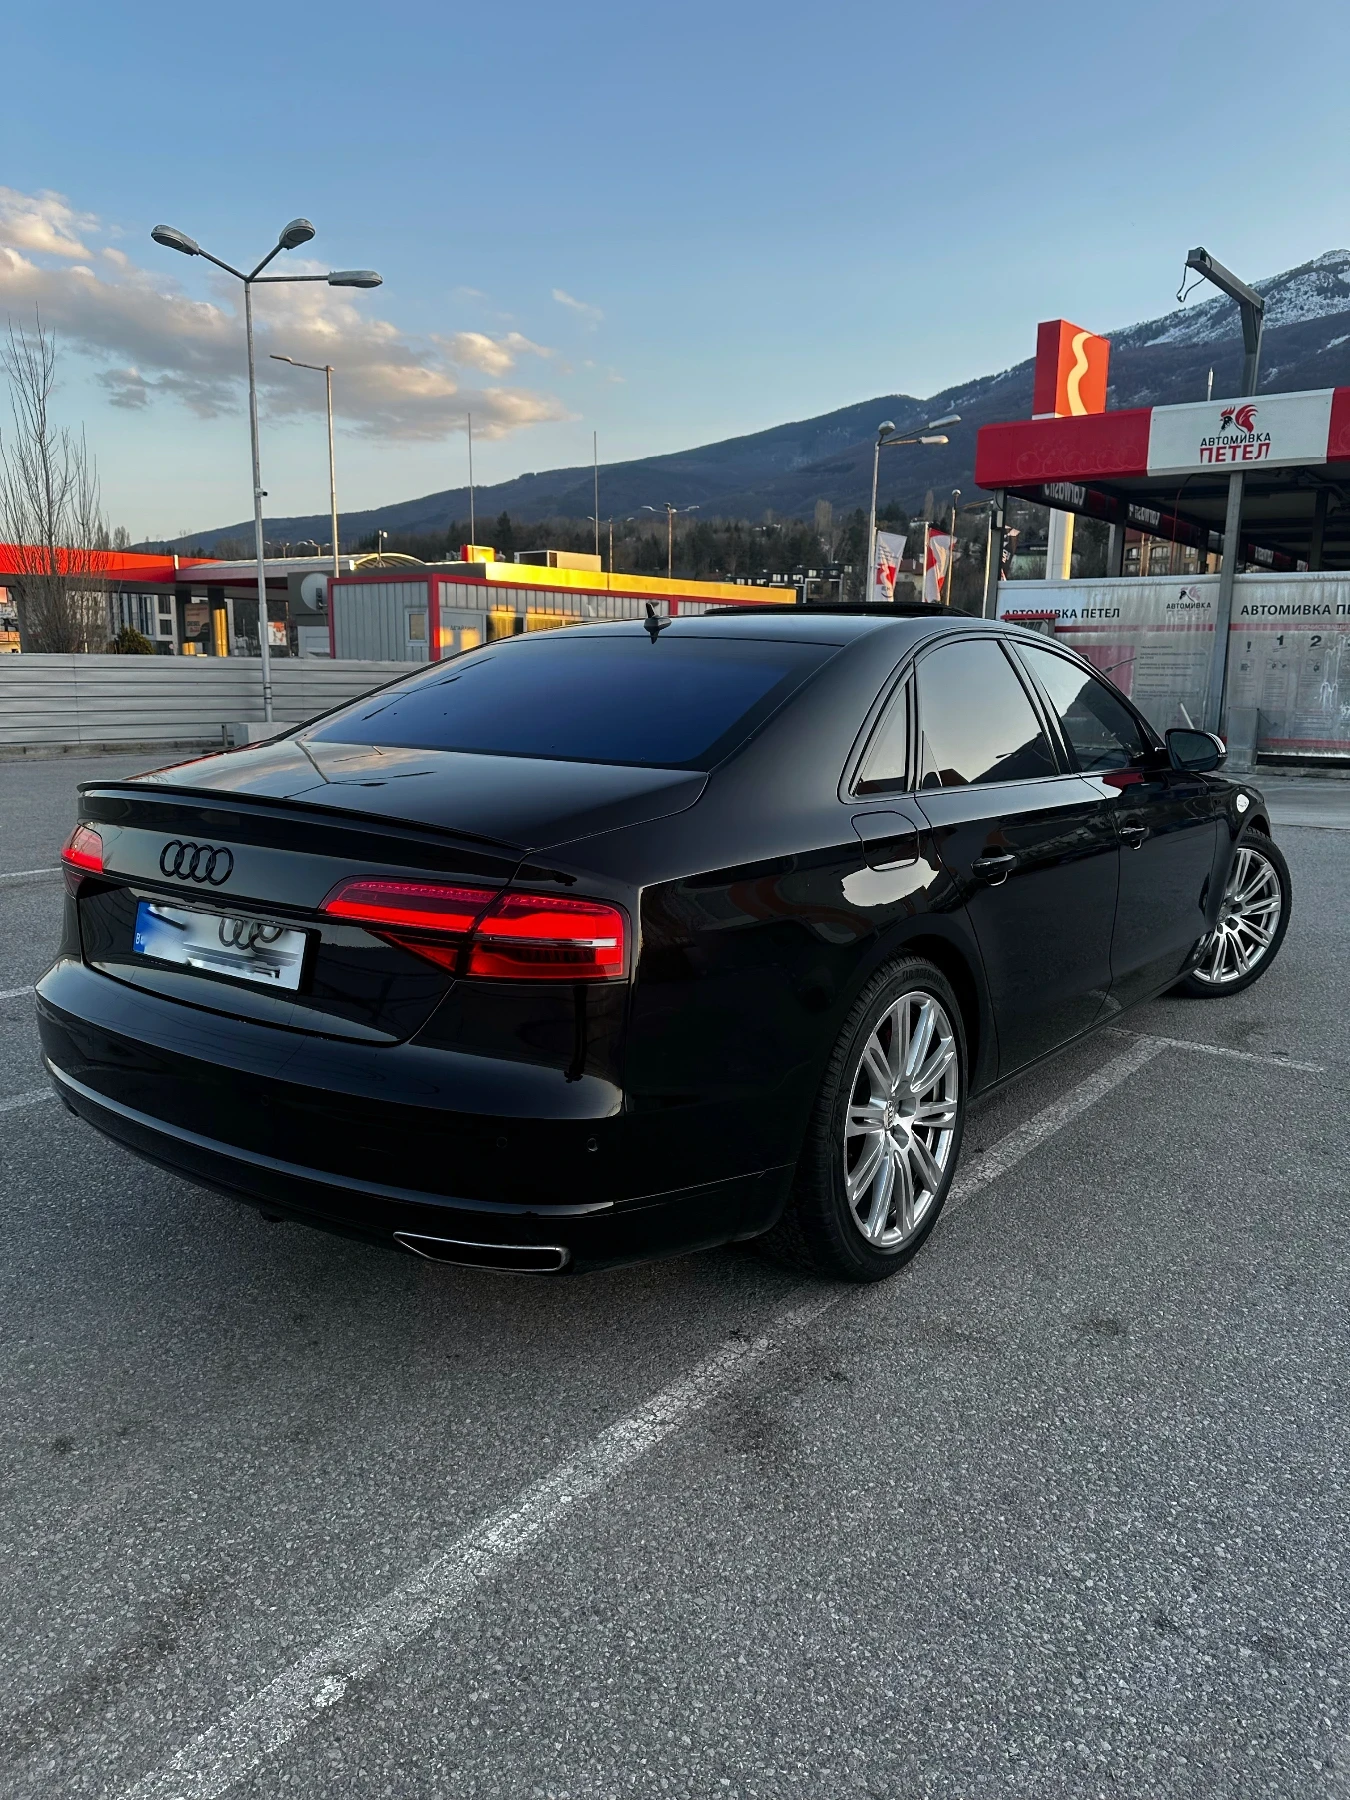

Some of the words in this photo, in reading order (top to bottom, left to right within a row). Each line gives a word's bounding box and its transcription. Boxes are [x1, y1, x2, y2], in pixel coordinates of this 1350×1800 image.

[1200, 432, 1271, 447] АВТОМИВКА
[1199, 442, 1270, 463] ПЕТЕЛ
[1081, 608, 1120, 618] ПЕТЕЛ
[1240, 604, 1332, 616] АВТОМИВКА
[1276, 635, 1285, 646] 1
[1309, 635, 1323, 648] 2
